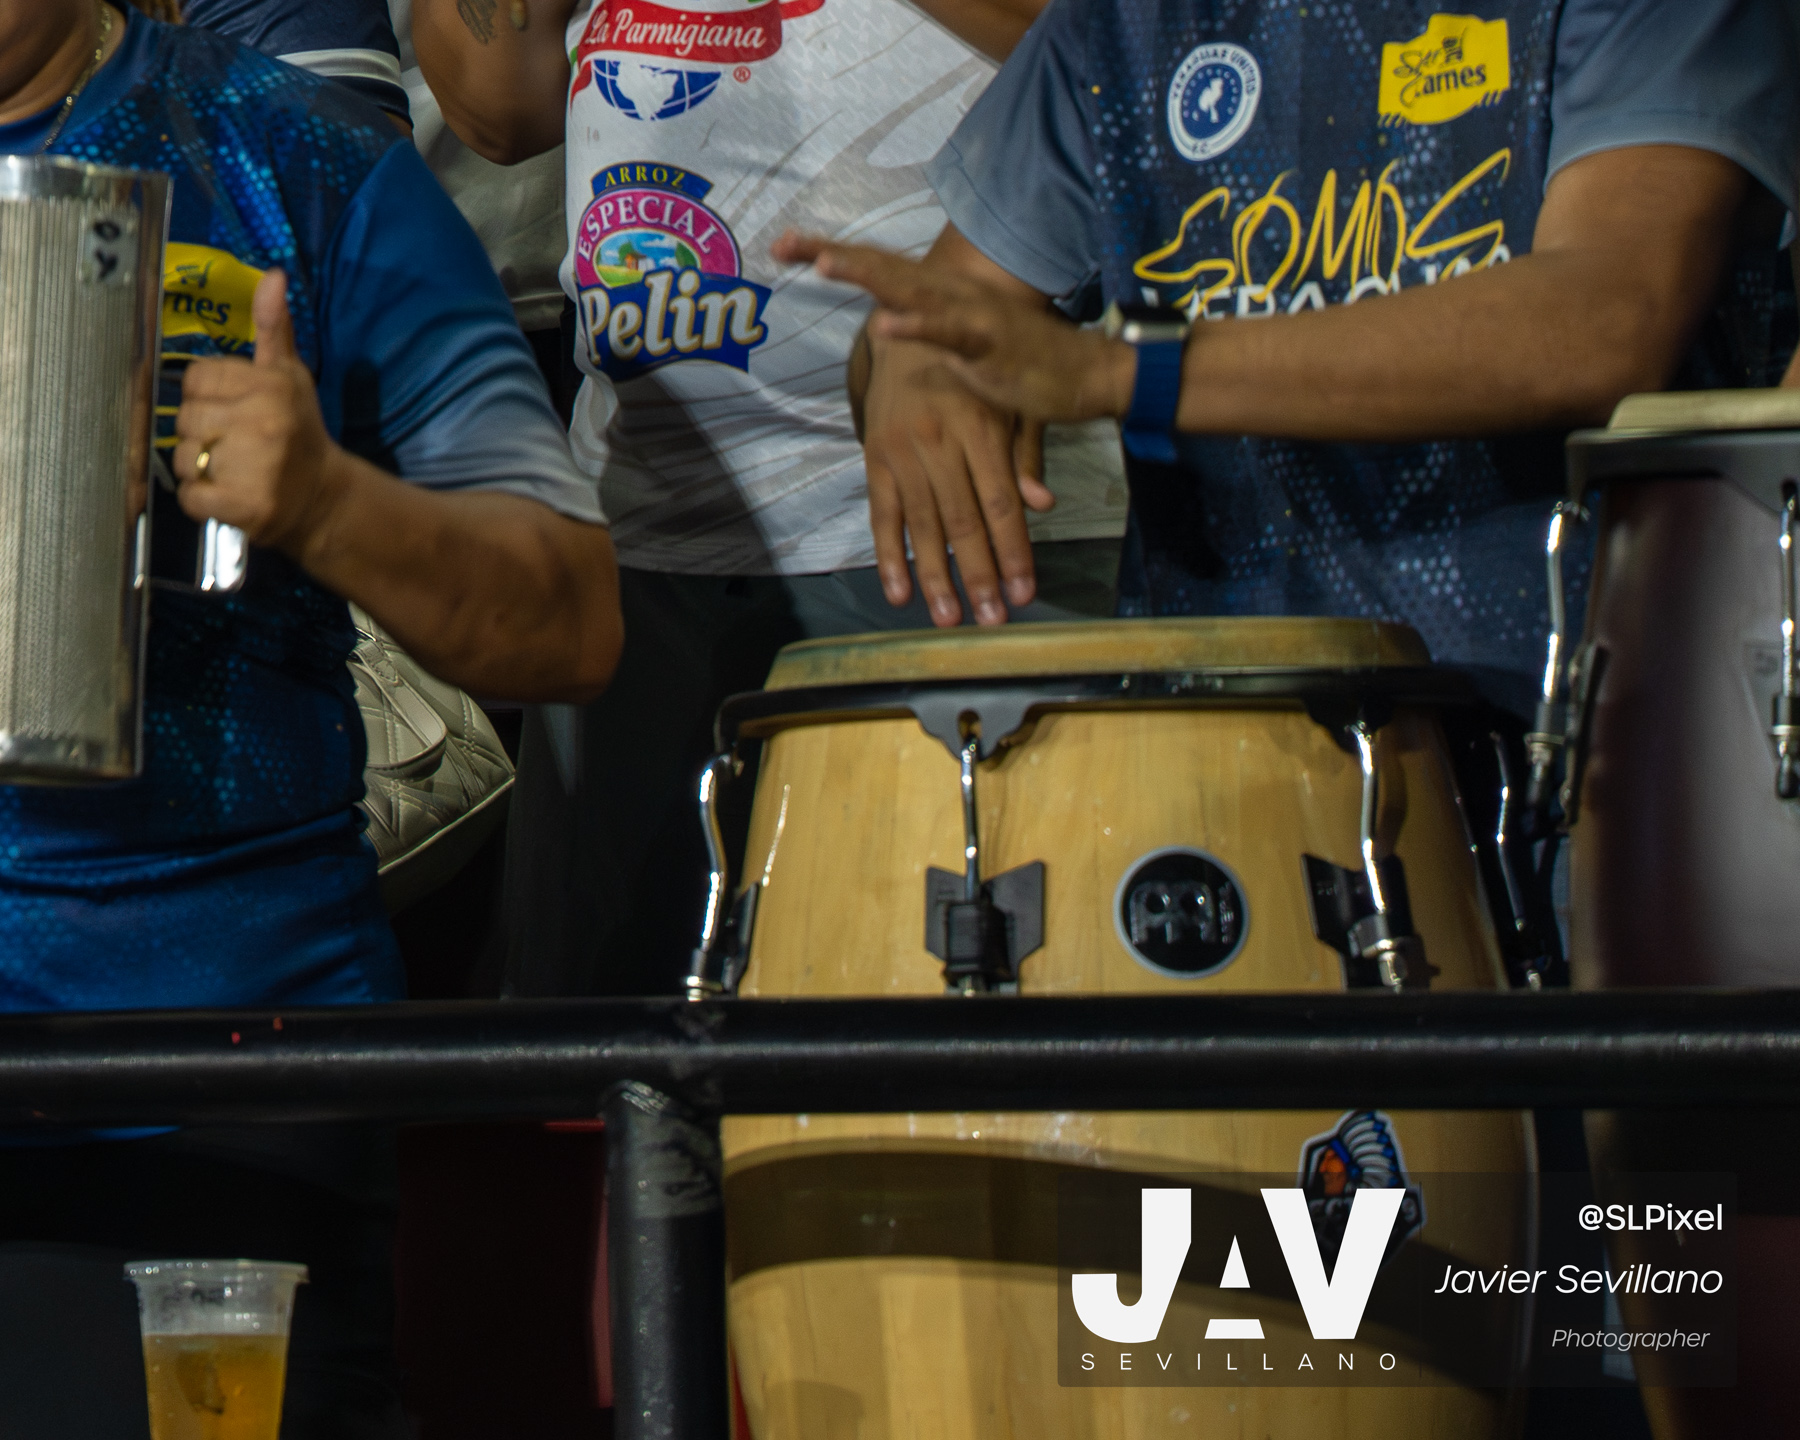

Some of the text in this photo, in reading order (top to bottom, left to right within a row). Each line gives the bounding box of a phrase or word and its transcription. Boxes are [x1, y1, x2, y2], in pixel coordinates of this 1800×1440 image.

[613, 8, 767, 56] Parmigiana
[605, 165, 685, 188] ARROZ
[578, 196, 718, 262] ESPECIAL
[579, 270, 765, 365] Pelin
